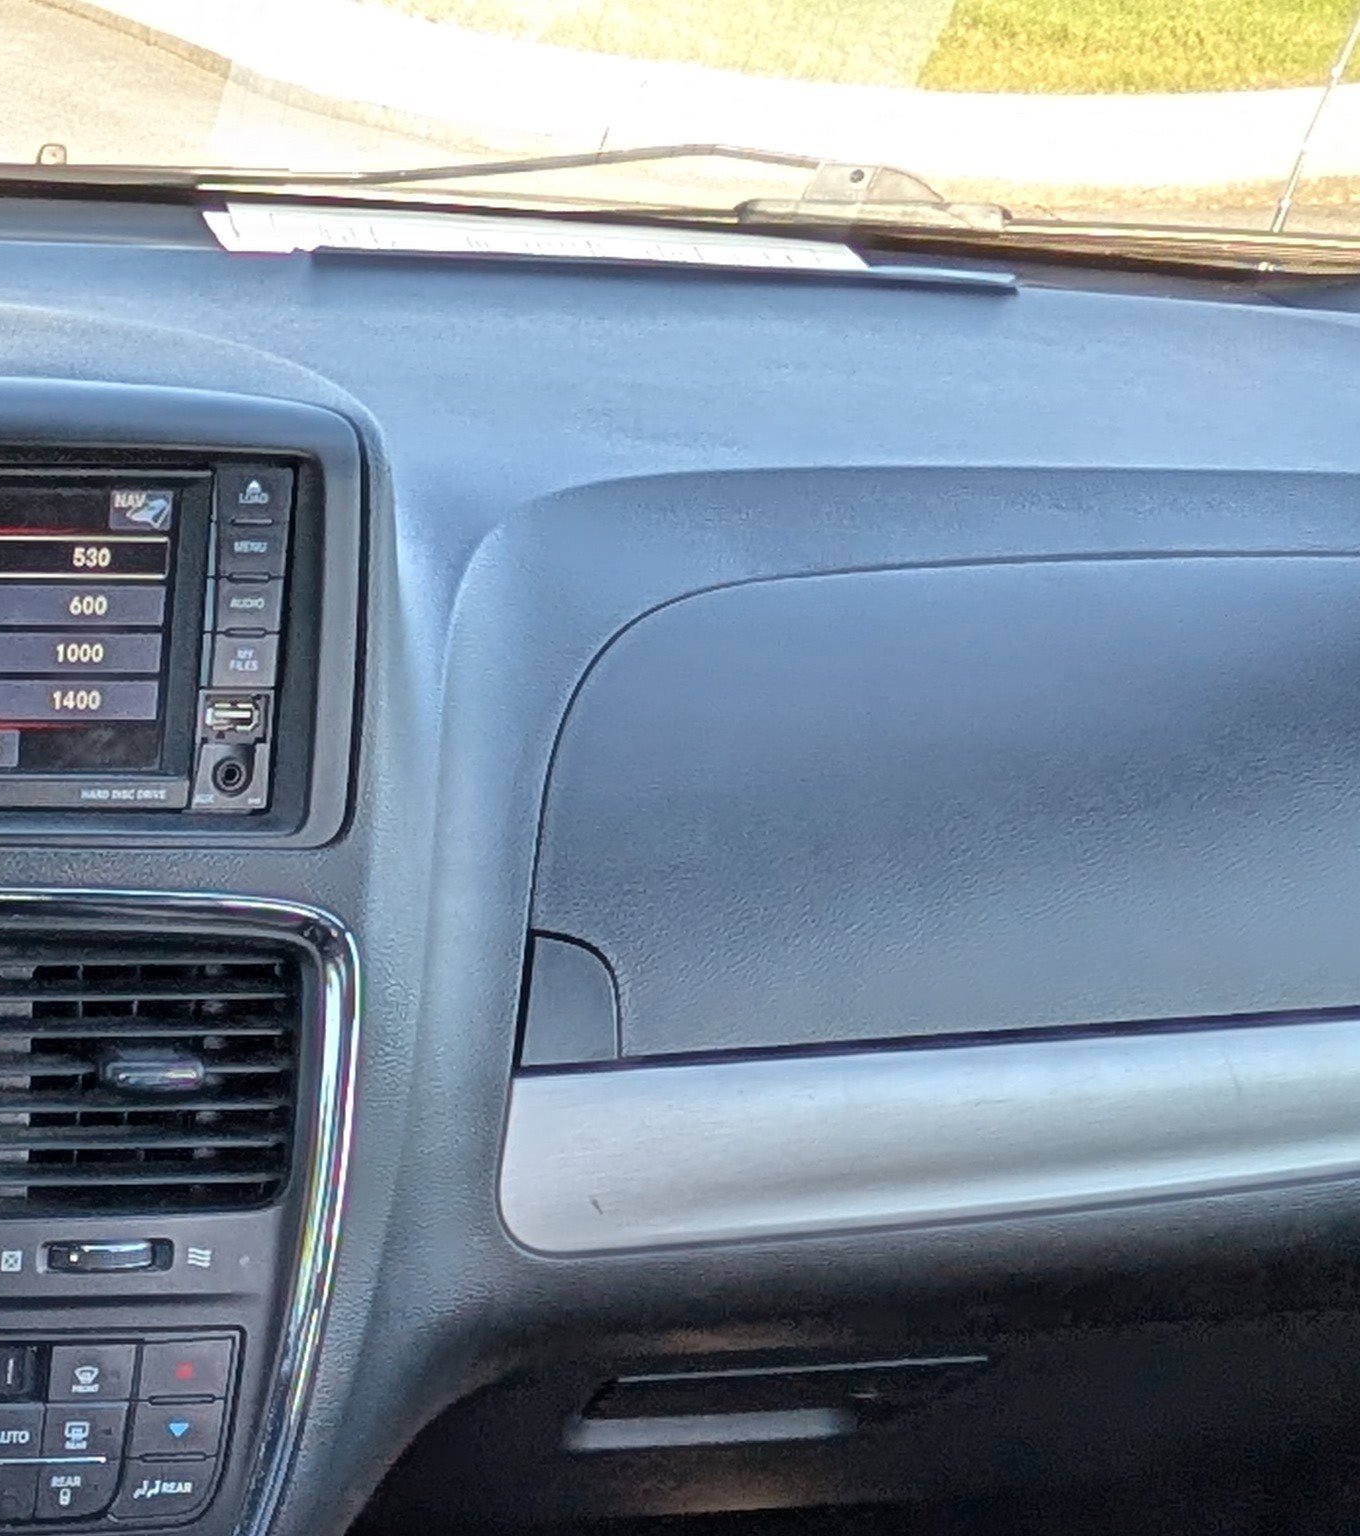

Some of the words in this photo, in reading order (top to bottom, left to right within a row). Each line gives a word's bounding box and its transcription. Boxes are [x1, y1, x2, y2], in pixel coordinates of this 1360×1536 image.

[113, 494, 147, 508] NAV
[72, 547, 112, 567] 530
[68, 595, 108, 616] 600
[55, 643, 105, 663] 1000
[52, 690, 102, 710] 1400
[50, 1476, 81, 1488] REAR
[160, 1482, 193, 1494] REAR
